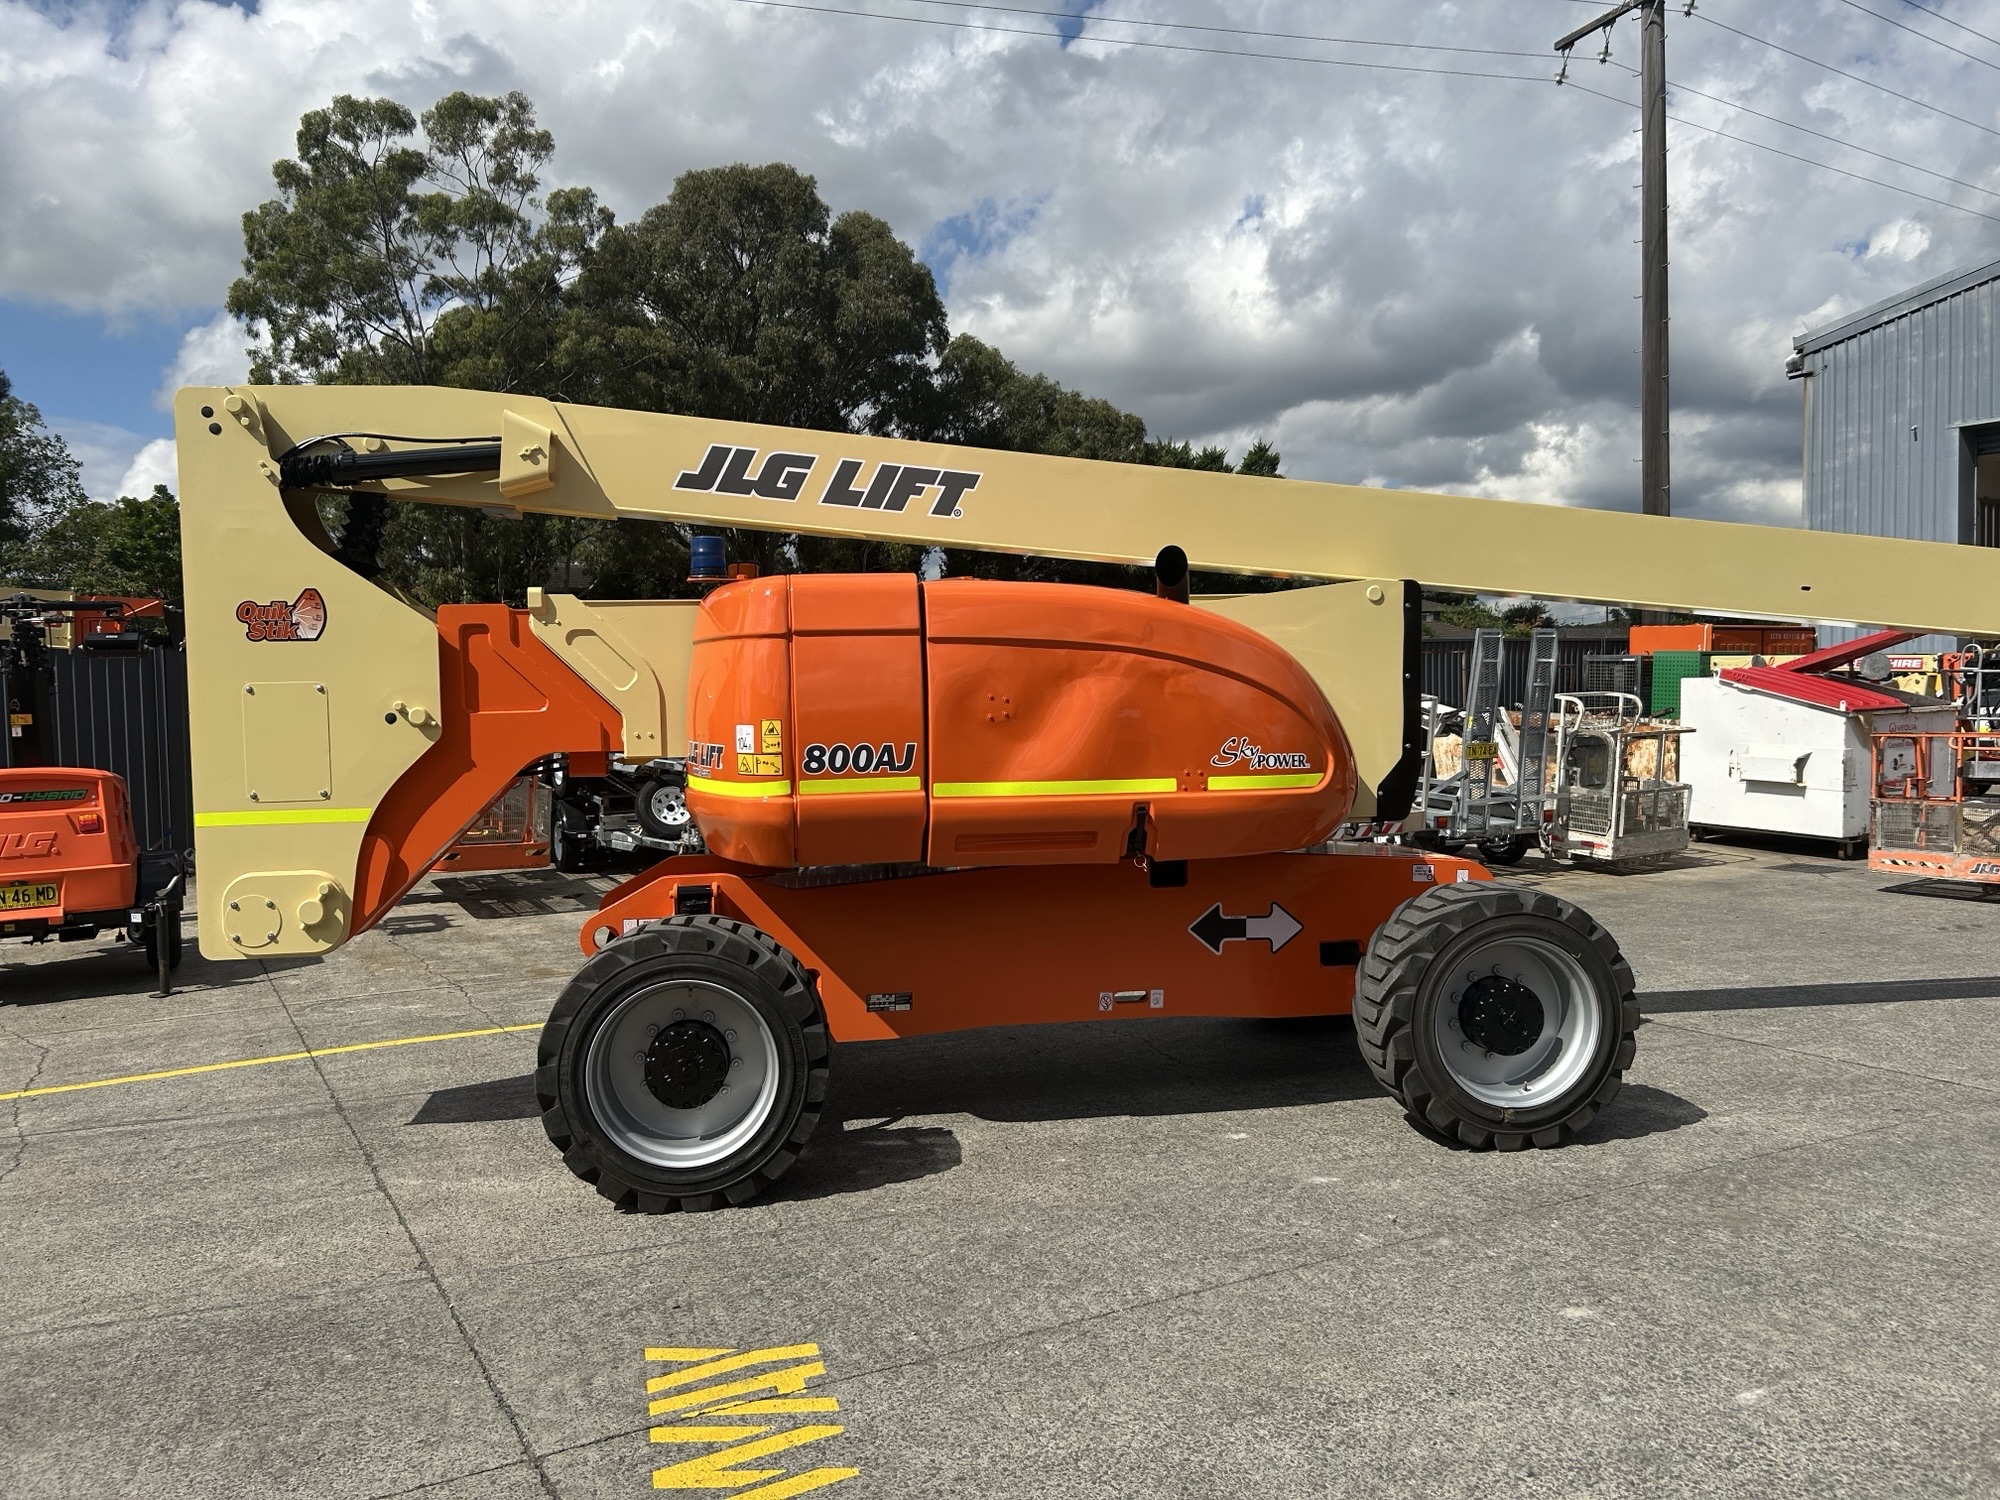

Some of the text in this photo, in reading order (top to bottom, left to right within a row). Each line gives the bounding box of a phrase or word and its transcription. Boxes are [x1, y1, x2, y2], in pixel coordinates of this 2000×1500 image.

[672, 444, 819, 502] JLG
[237, 602, 293, 623] Quik
[247, 621, 298, 640] Stik
[1897, 723, 1917, 731] VEOLIA
[700, 743, 725, 769] LIFT
[803, 743, 917, 774] 800AJ
[1210, 736, 1307, 770] Sky POWER
[0, 790, 87, 803] O-HYBRID
[1968, 862, 2000, 876] JLG
